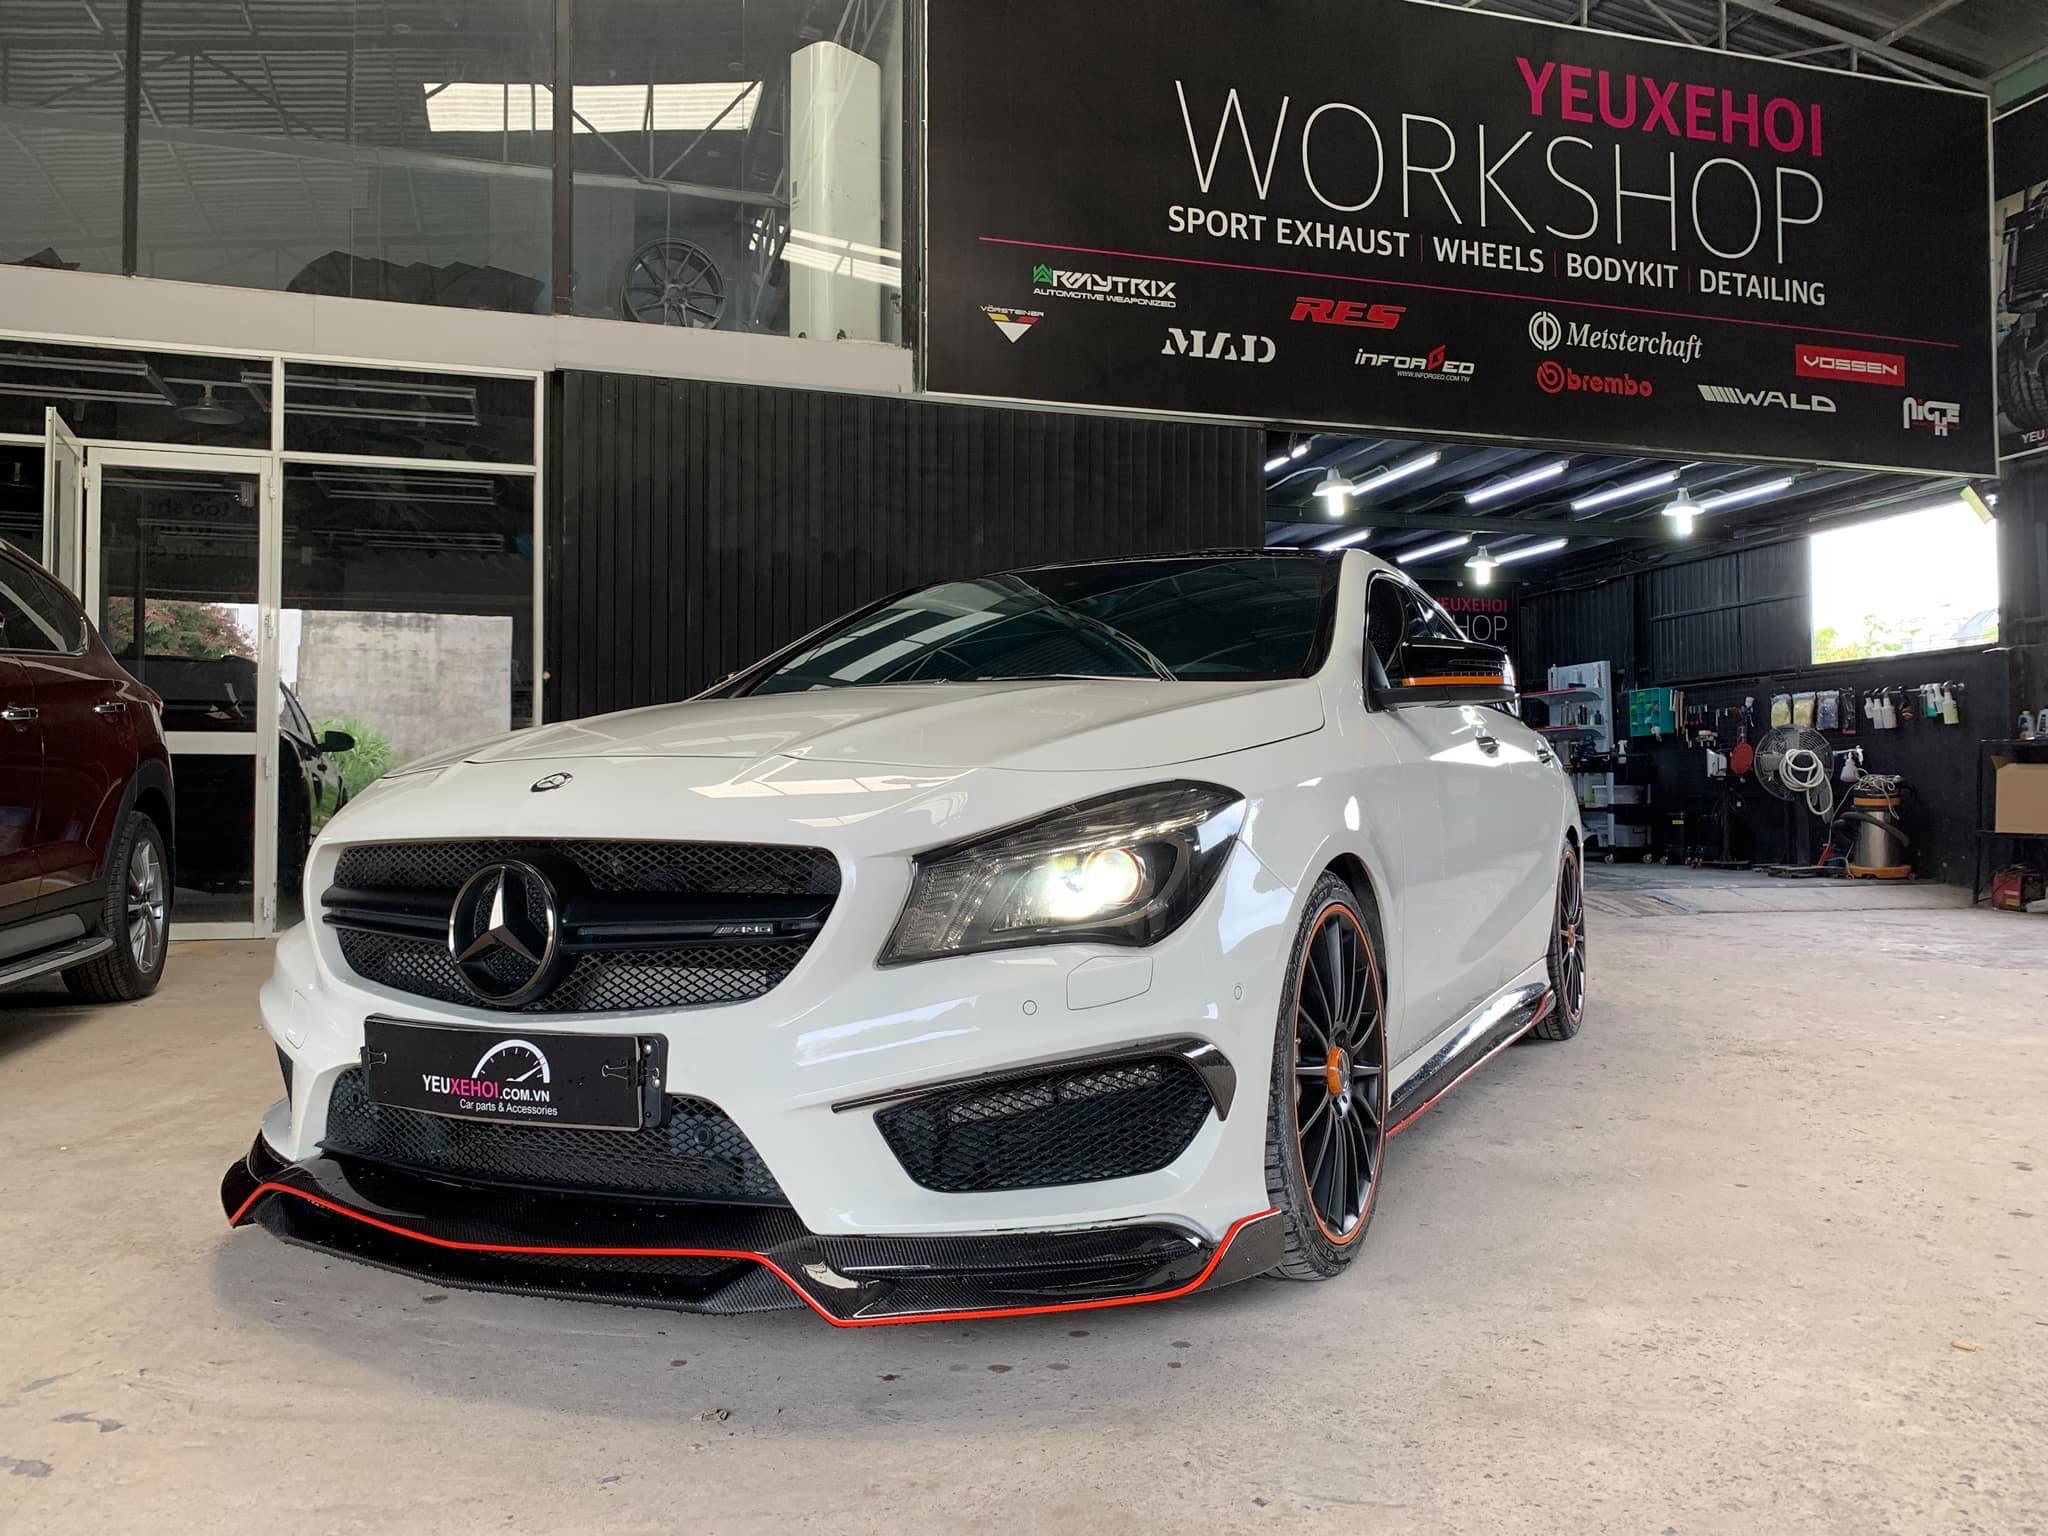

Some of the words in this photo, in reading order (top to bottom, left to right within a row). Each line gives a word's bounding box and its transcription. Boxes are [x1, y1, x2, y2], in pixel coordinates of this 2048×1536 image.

[1516, 57, 1823, 156] YEUXEHOI
[1175, 80, 1824, 264] WORKSHOP
[1168, 205, 1267, 241] SPORT
[1276, 217, 1410, 258] EXHAUST
[1432, 236, 1544, 274] WHEELS
[1566, 252, 1679, 289] BODYKIT
[1699, 268, 1826, 306] DETAILING
[1033, 287, 1105, 301] AUTOMOTIVE
[1105, 295, 1177, 308] WEAPONIZED
[1289, 296, 1407, 330] RES
[1161, 327, 1277, 364] MAD
[1566, 321, 1703, 364] Meisterchaft
[1803, 355, 1898, 376] VOSSEN
[1567, 367, 1653, 397] brembo
[1735, 387, 1837, 413] WALD
[2021, 427, 2048, 444] YEU
[422, 1074, 550, 1102] YEUXEHOI.COM.VN
[459, 1098, 474, 1110] Car
[475, 1100, 497, 1113] parts
[497, 1102, 505, 1113] &
[506, 1102, 559, 1117] Accessories
